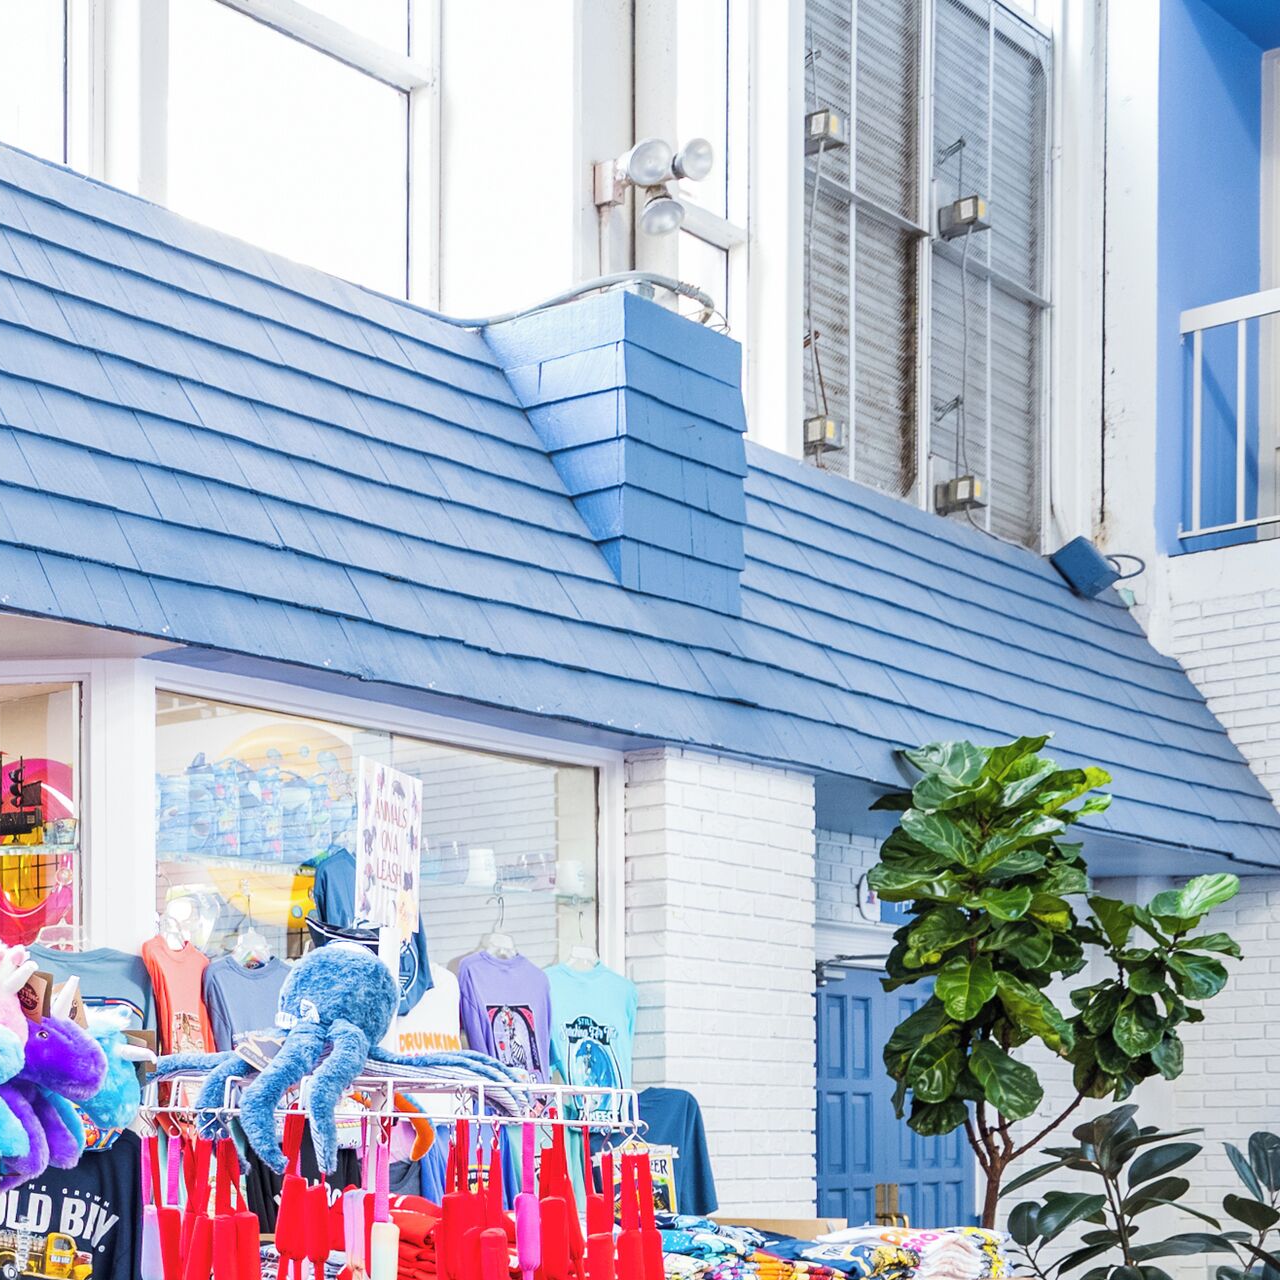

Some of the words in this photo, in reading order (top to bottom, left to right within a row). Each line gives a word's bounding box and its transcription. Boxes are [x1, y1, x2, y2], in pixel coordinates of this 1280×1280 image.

[375, 797, 408, 829] ANIMALS
[381, 830, 391, 849] ON
[376, 857, 402, 886] LEASH
